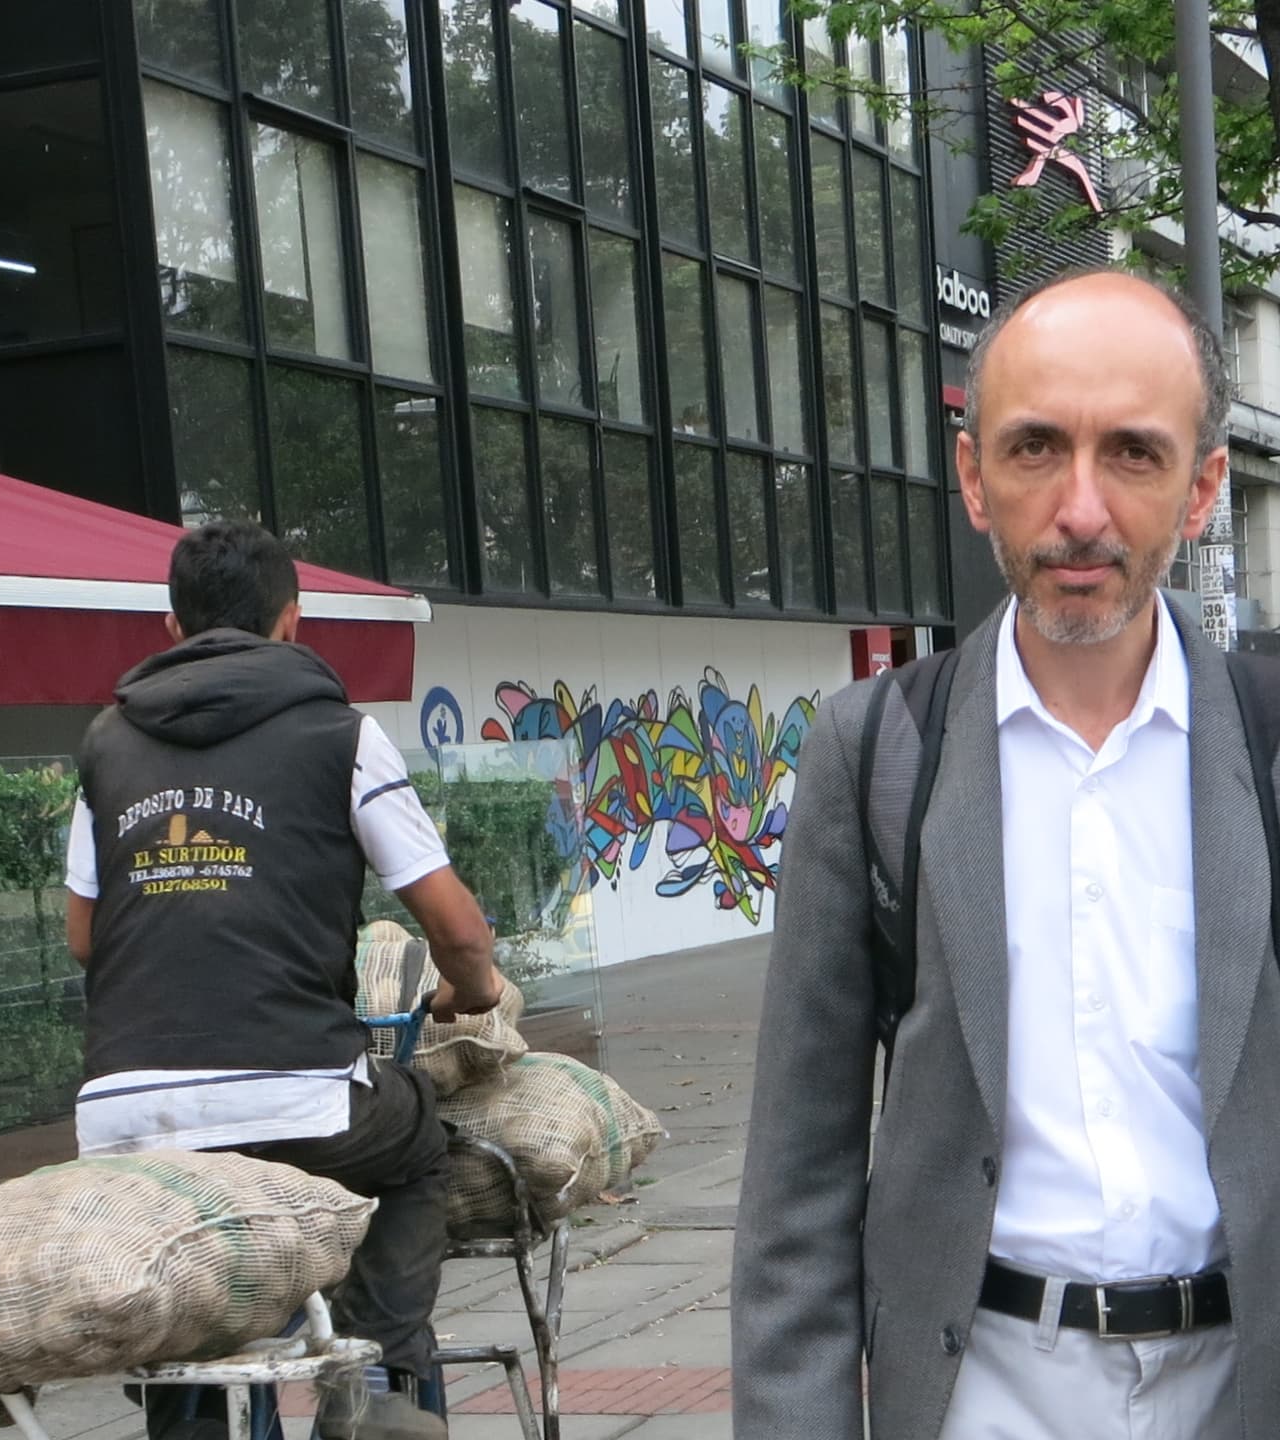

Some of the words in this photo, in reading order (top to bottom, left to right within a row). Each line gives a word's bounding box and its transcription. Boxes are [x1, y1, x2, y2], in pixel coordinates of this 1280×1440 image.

[117, 789, 185, 838] DEPOSITO
[192, 786, 214, 809] DE
[222, 790, 265, 830] PAPA
[133, 850, 153, 869] EL
[158, 845, 247, 864] SURTIDOR
